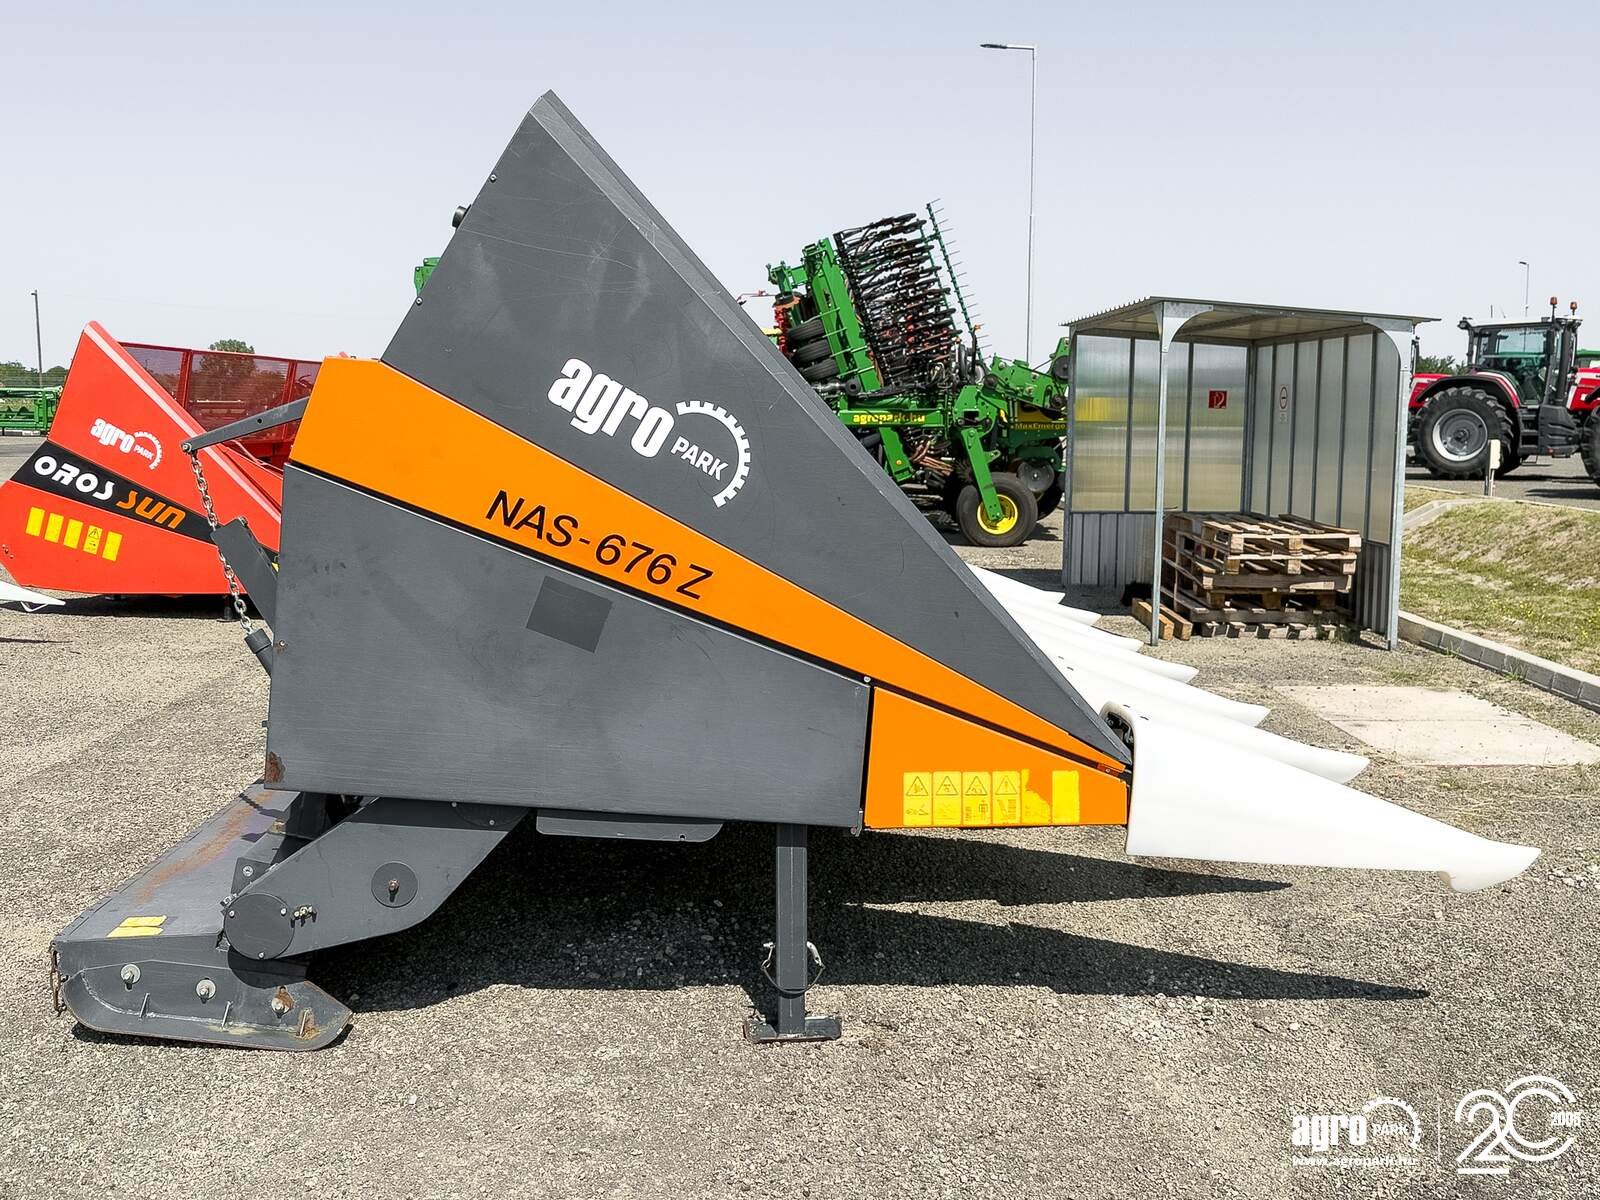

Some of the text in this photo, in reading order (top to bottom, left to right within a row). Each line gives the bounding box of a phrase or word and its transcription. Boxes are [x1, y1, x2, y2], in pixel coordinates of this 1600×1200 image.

[90, 418, 154, 461] agro PARK
[547, 358, 729, 481] agro PARK
[33, 455, 115, 501] OROS
